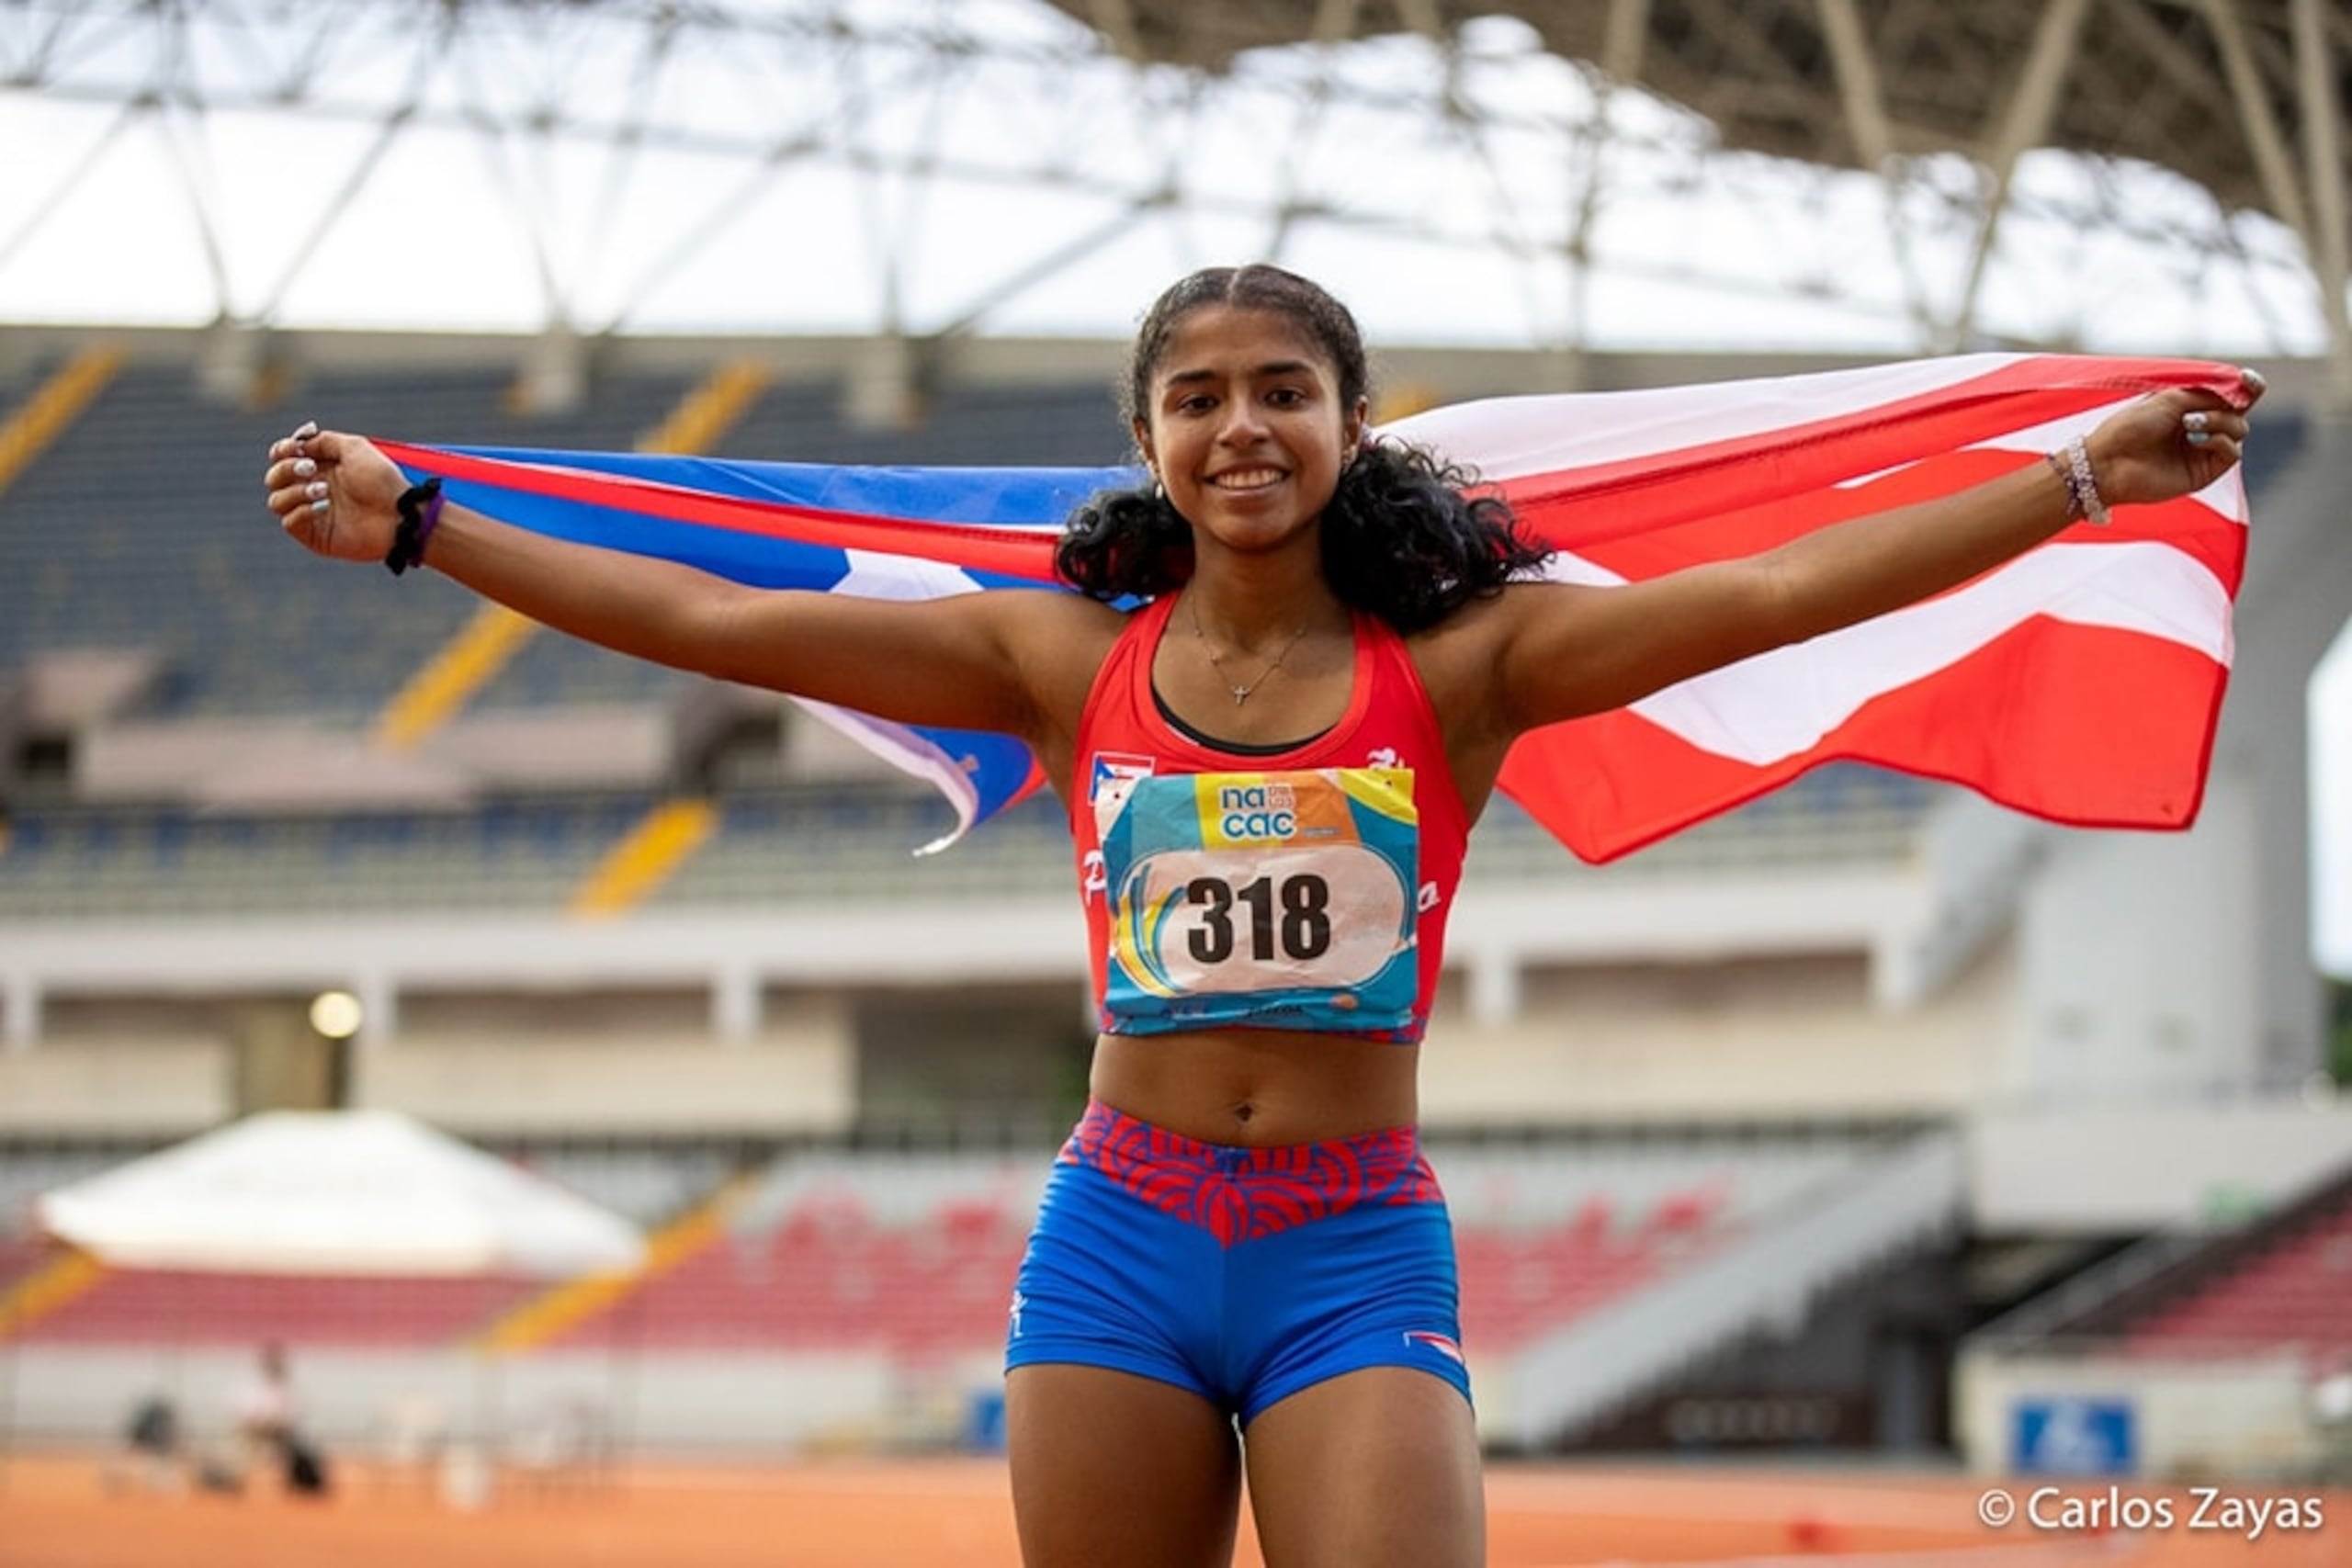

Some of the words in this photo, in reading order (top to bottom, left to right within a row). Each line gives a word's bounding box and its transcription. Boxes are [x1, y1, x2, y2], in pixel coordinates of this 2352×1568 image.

[1222, 788, 1265, 808] na
[1224, 812, 1294, 838] cac
[1187, 874, 1331, 964] 318
